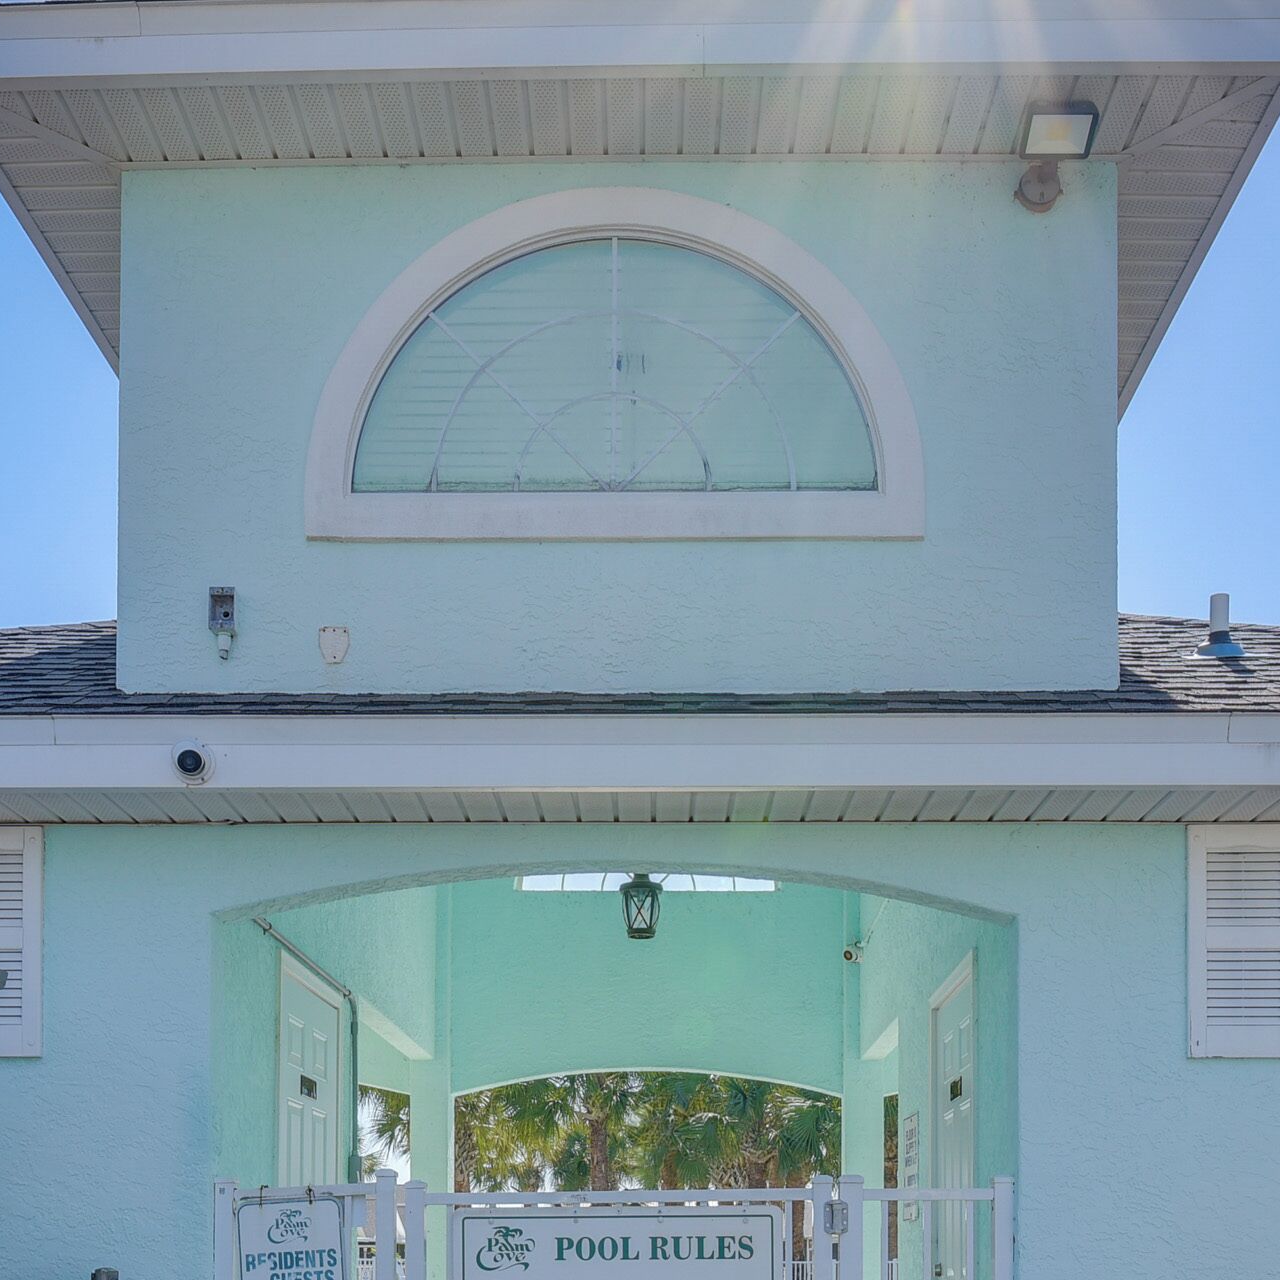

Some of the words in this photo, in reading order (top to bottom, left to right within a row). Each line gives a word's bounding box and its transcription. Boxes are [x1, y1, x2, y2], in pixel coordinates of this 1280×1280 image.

[274, 1217, 311, 1230] Palm
[486, 1236, 535, 1253] Palm
[554, 1236, 640, 1261] POOL
[648, 1235, 754, 1261] RULES
[245, 1248, 338, 1272] RESIDENTS
